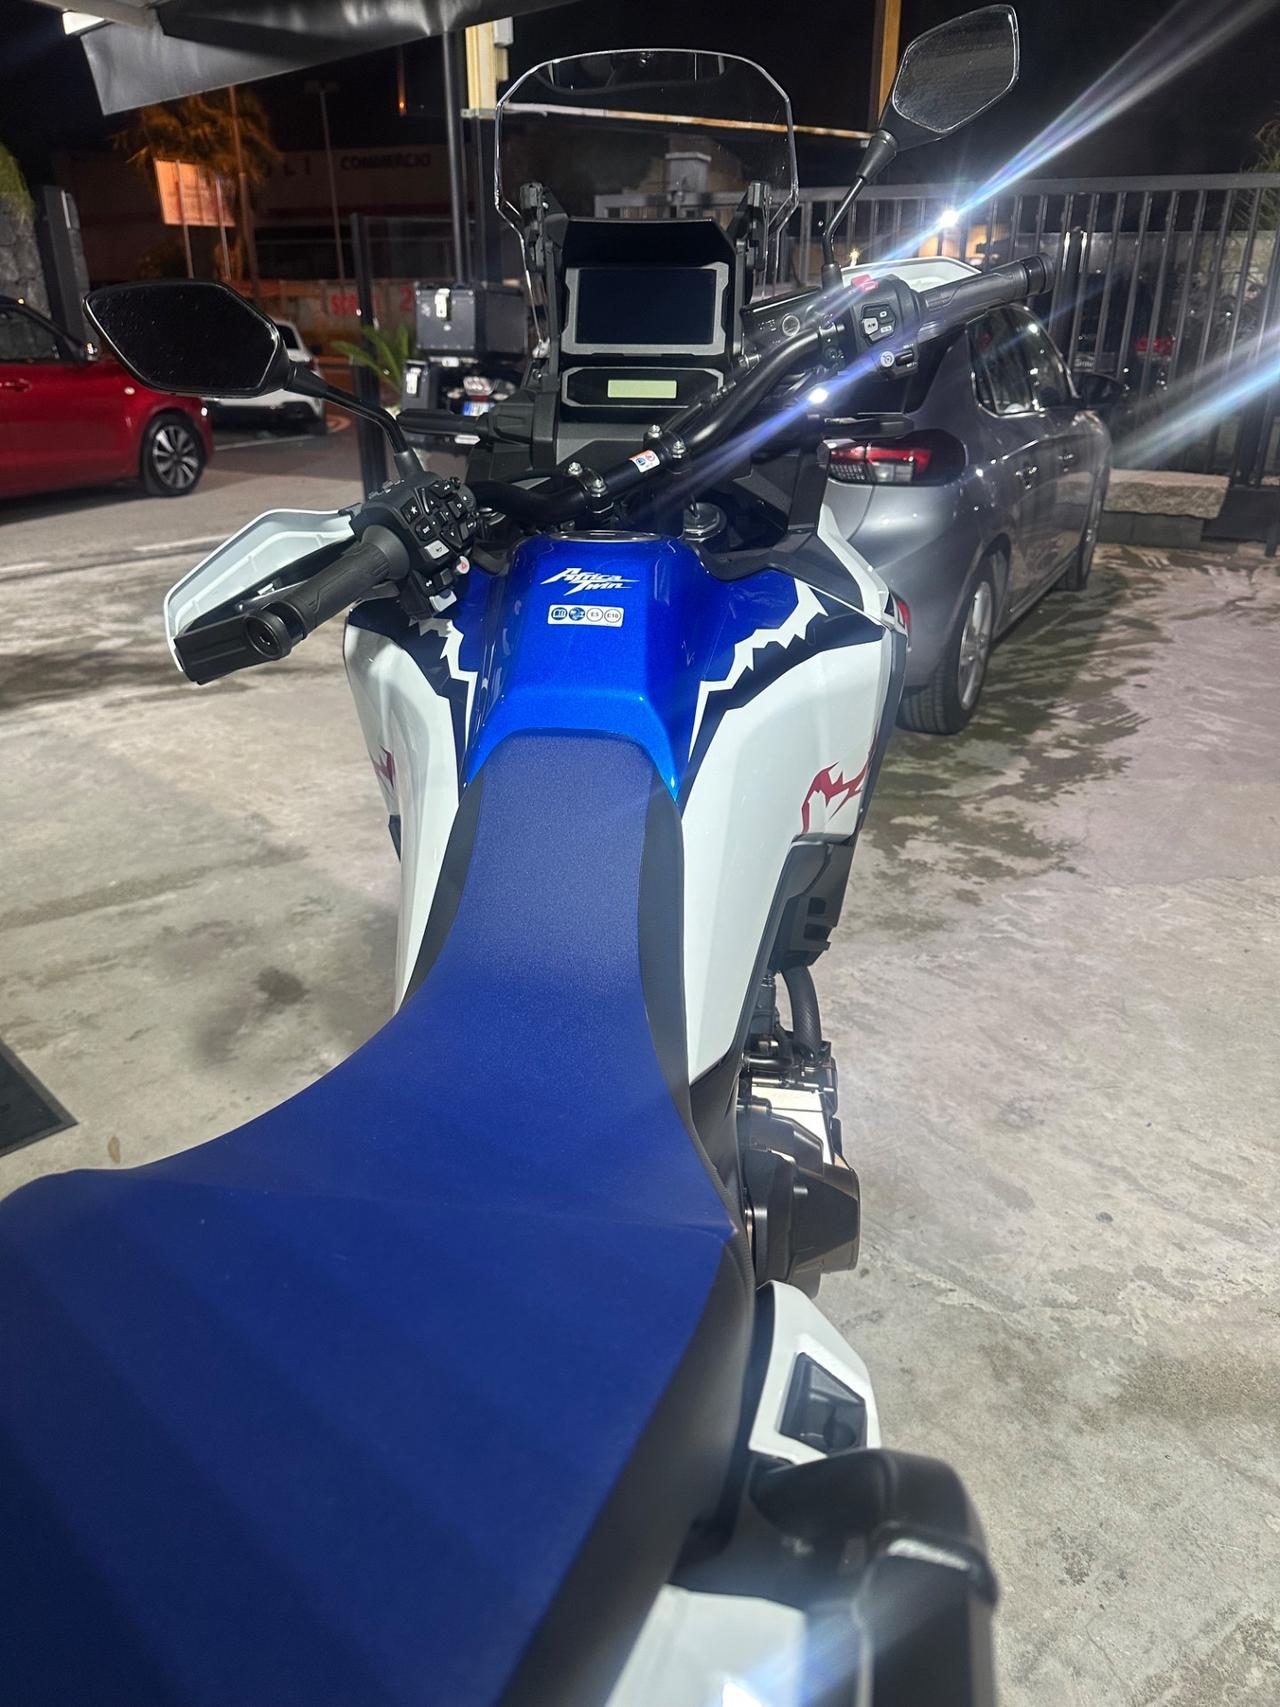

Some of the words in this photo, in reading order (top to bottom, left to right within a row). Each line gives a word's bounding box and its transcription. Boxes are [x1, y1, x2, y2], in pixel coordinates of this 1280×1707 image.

[340, 153, 431, 170] COMMERCIO
[540, 567, 640, 585] Africa
[563, 581, 632, 596] Twin
